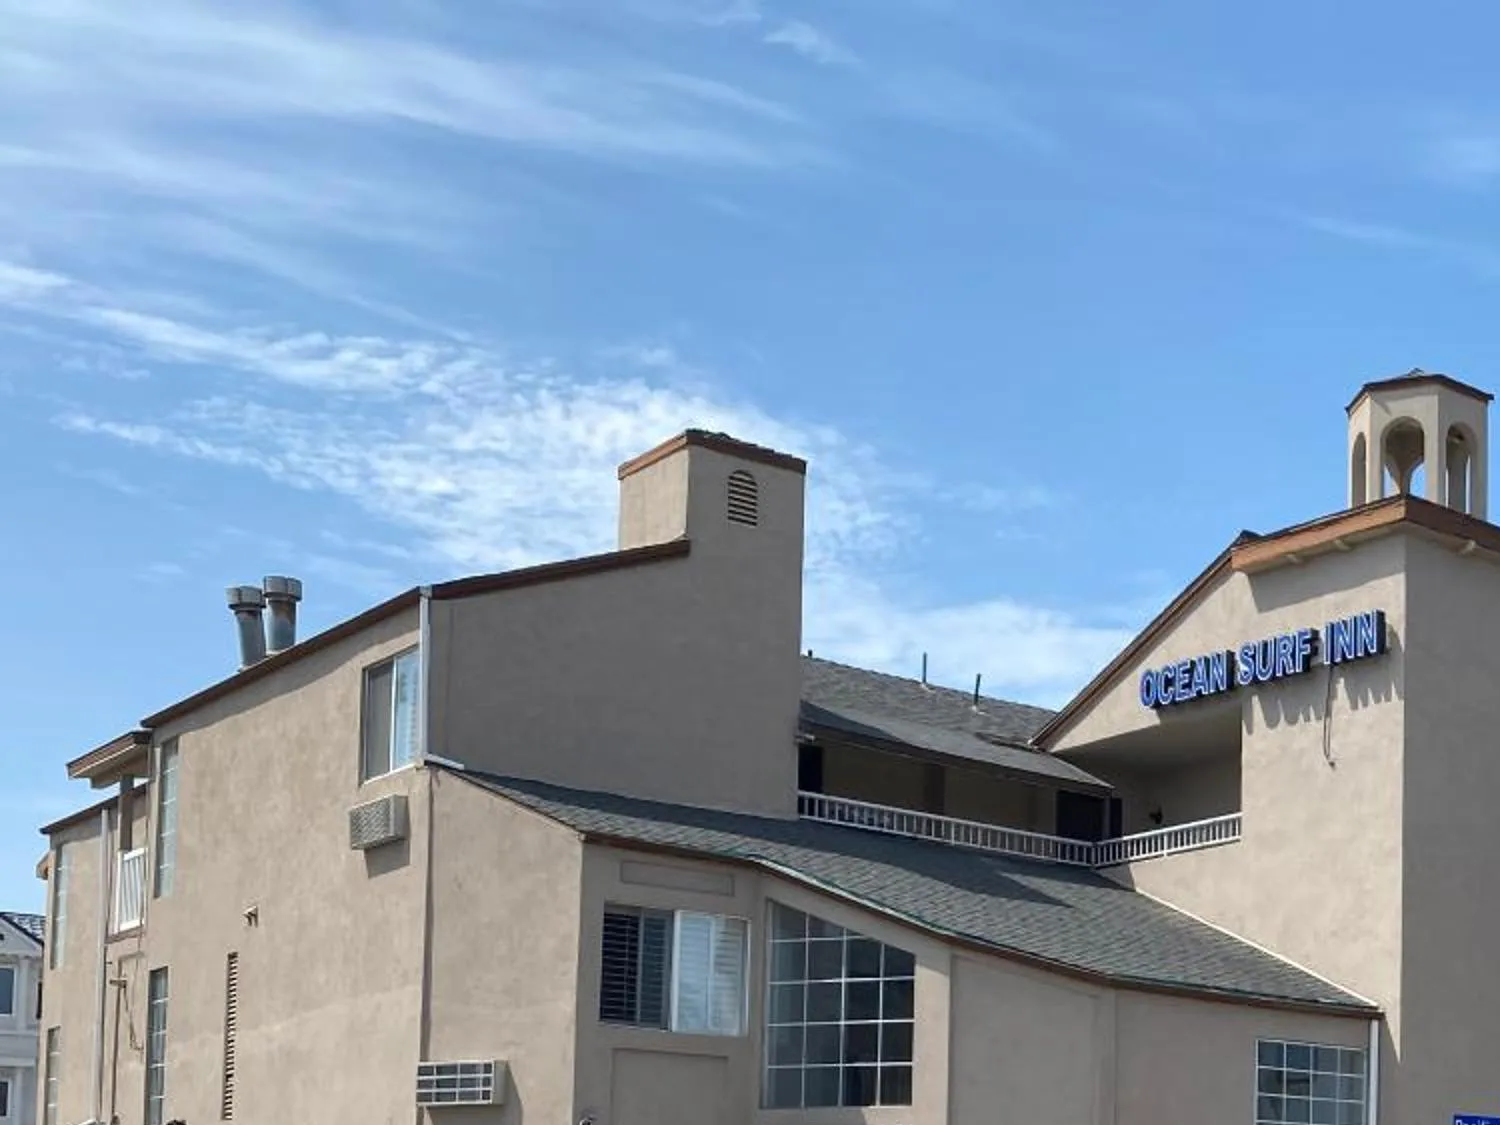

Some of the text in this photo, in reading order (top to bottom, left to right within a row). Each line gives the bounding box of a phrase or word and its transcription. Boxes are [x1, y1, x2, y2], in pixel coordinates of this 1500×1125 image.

[1140, 609, 1384, 708] OCEAN SURF INN
